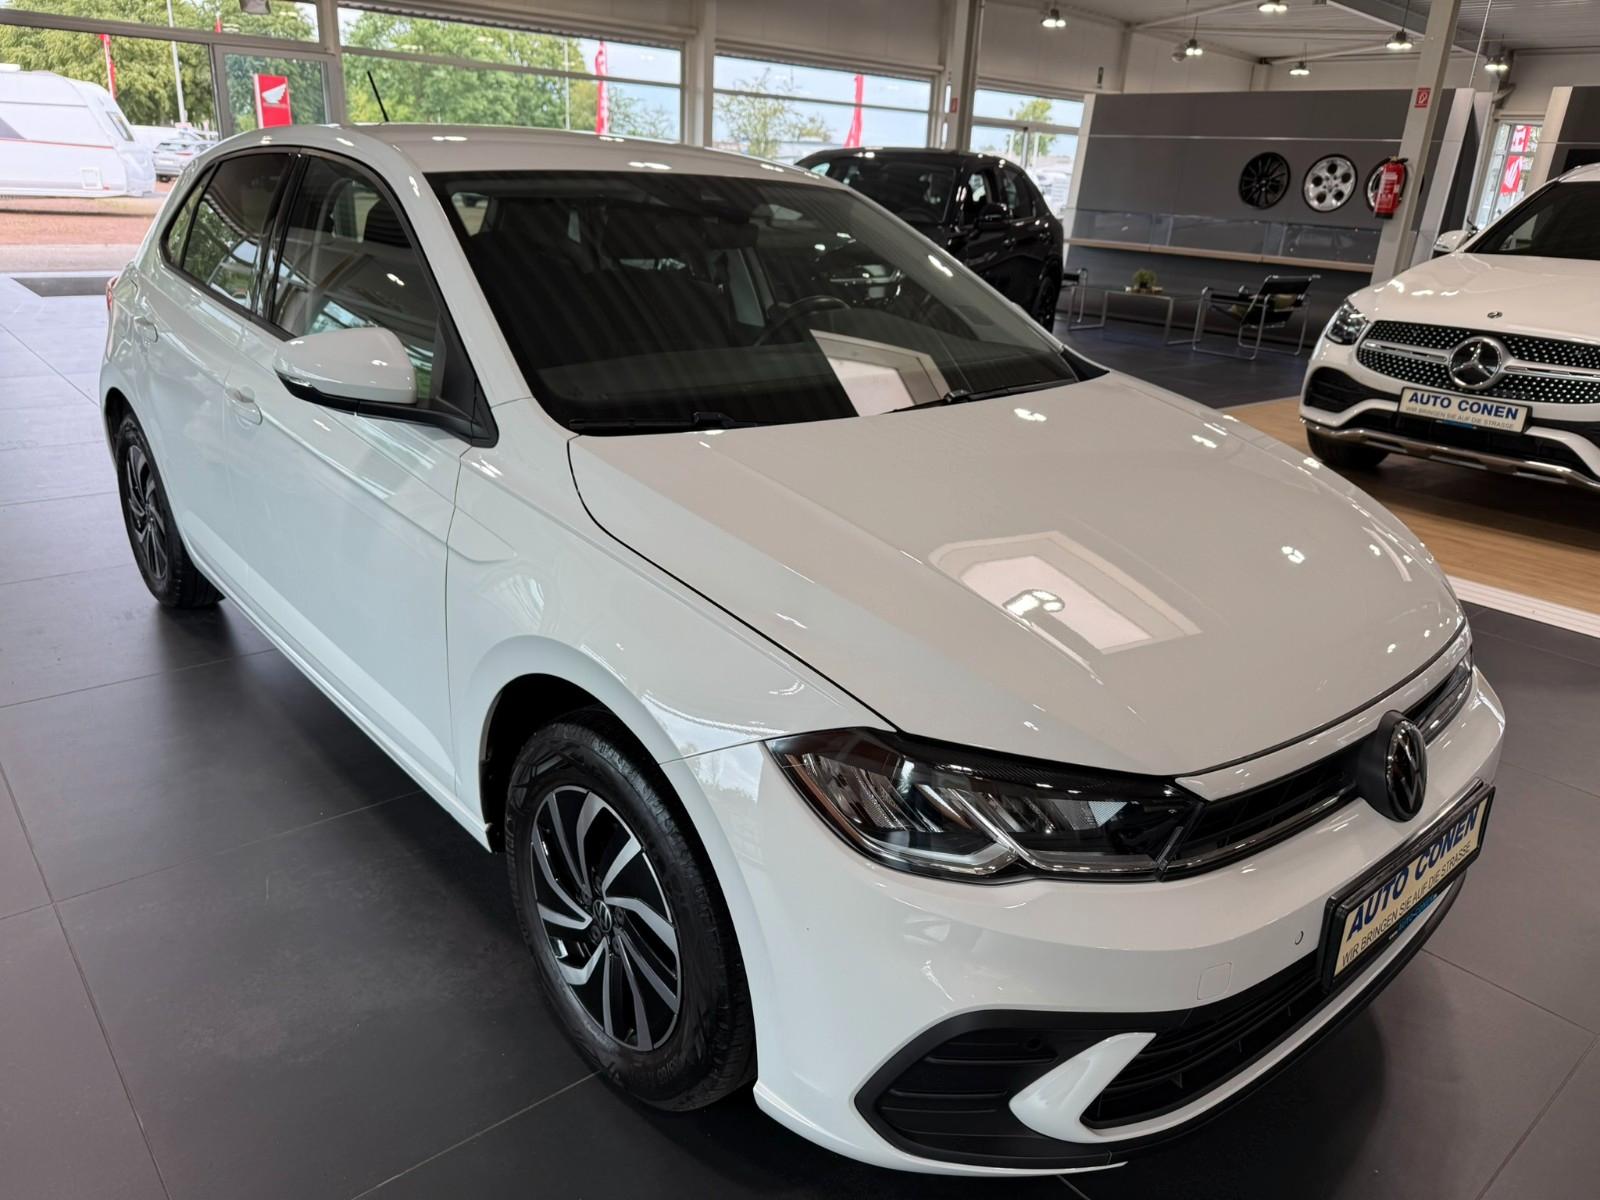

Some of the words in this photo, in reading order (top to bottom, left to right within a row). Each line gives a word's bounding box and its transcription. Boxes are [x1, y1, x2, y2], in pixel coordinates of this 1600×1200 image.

[1409, 392, 1452, 409] AUTO
[1457, 400, 1519, 420] CONEN
[1342, 942, 1360, 966] WIR
[1360, 913, 1397, 950] BRINGEN
[1399, 895, 1412, 915] SIE
[1412, 882, 1428, 904] AUF
[1428, 872, 1440, 890] DIE
[1441, 841, 1471, 874] STRASSE
[1346, 867, 1409, 941] AUTO
[1414, 807, 1477, 881] CONEN
